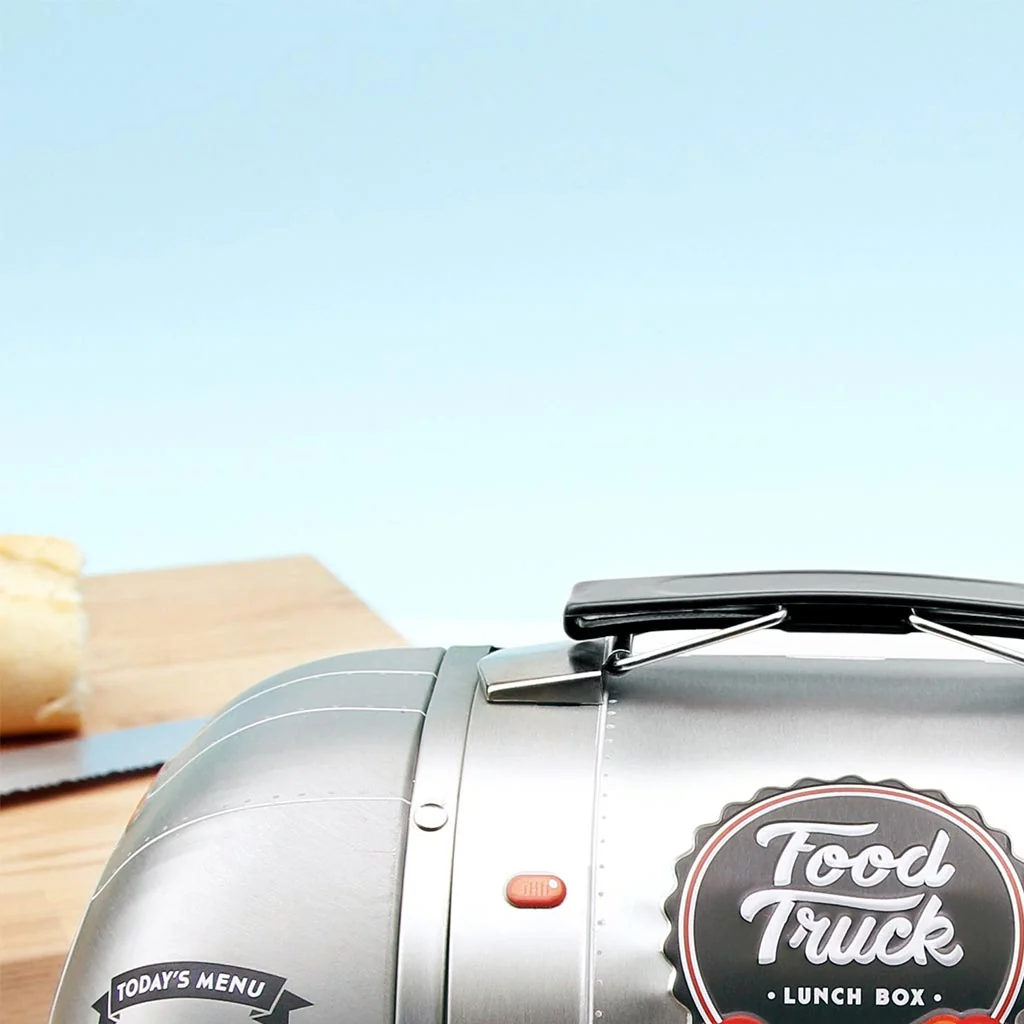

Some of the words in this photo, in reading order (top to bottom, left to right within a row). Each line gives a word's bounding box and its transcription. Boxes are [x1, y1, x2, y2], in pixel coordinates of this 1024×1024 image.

[756, 822, 956, 888] Food
[740, 889, 964, 967] Truck
[117, 970, 190, 1001] TODAY'S
[196, 972, 266, 998] MENU
[784, 987, 862, 1006] LUNCH
[875, 987, 925, 1007] BOX
